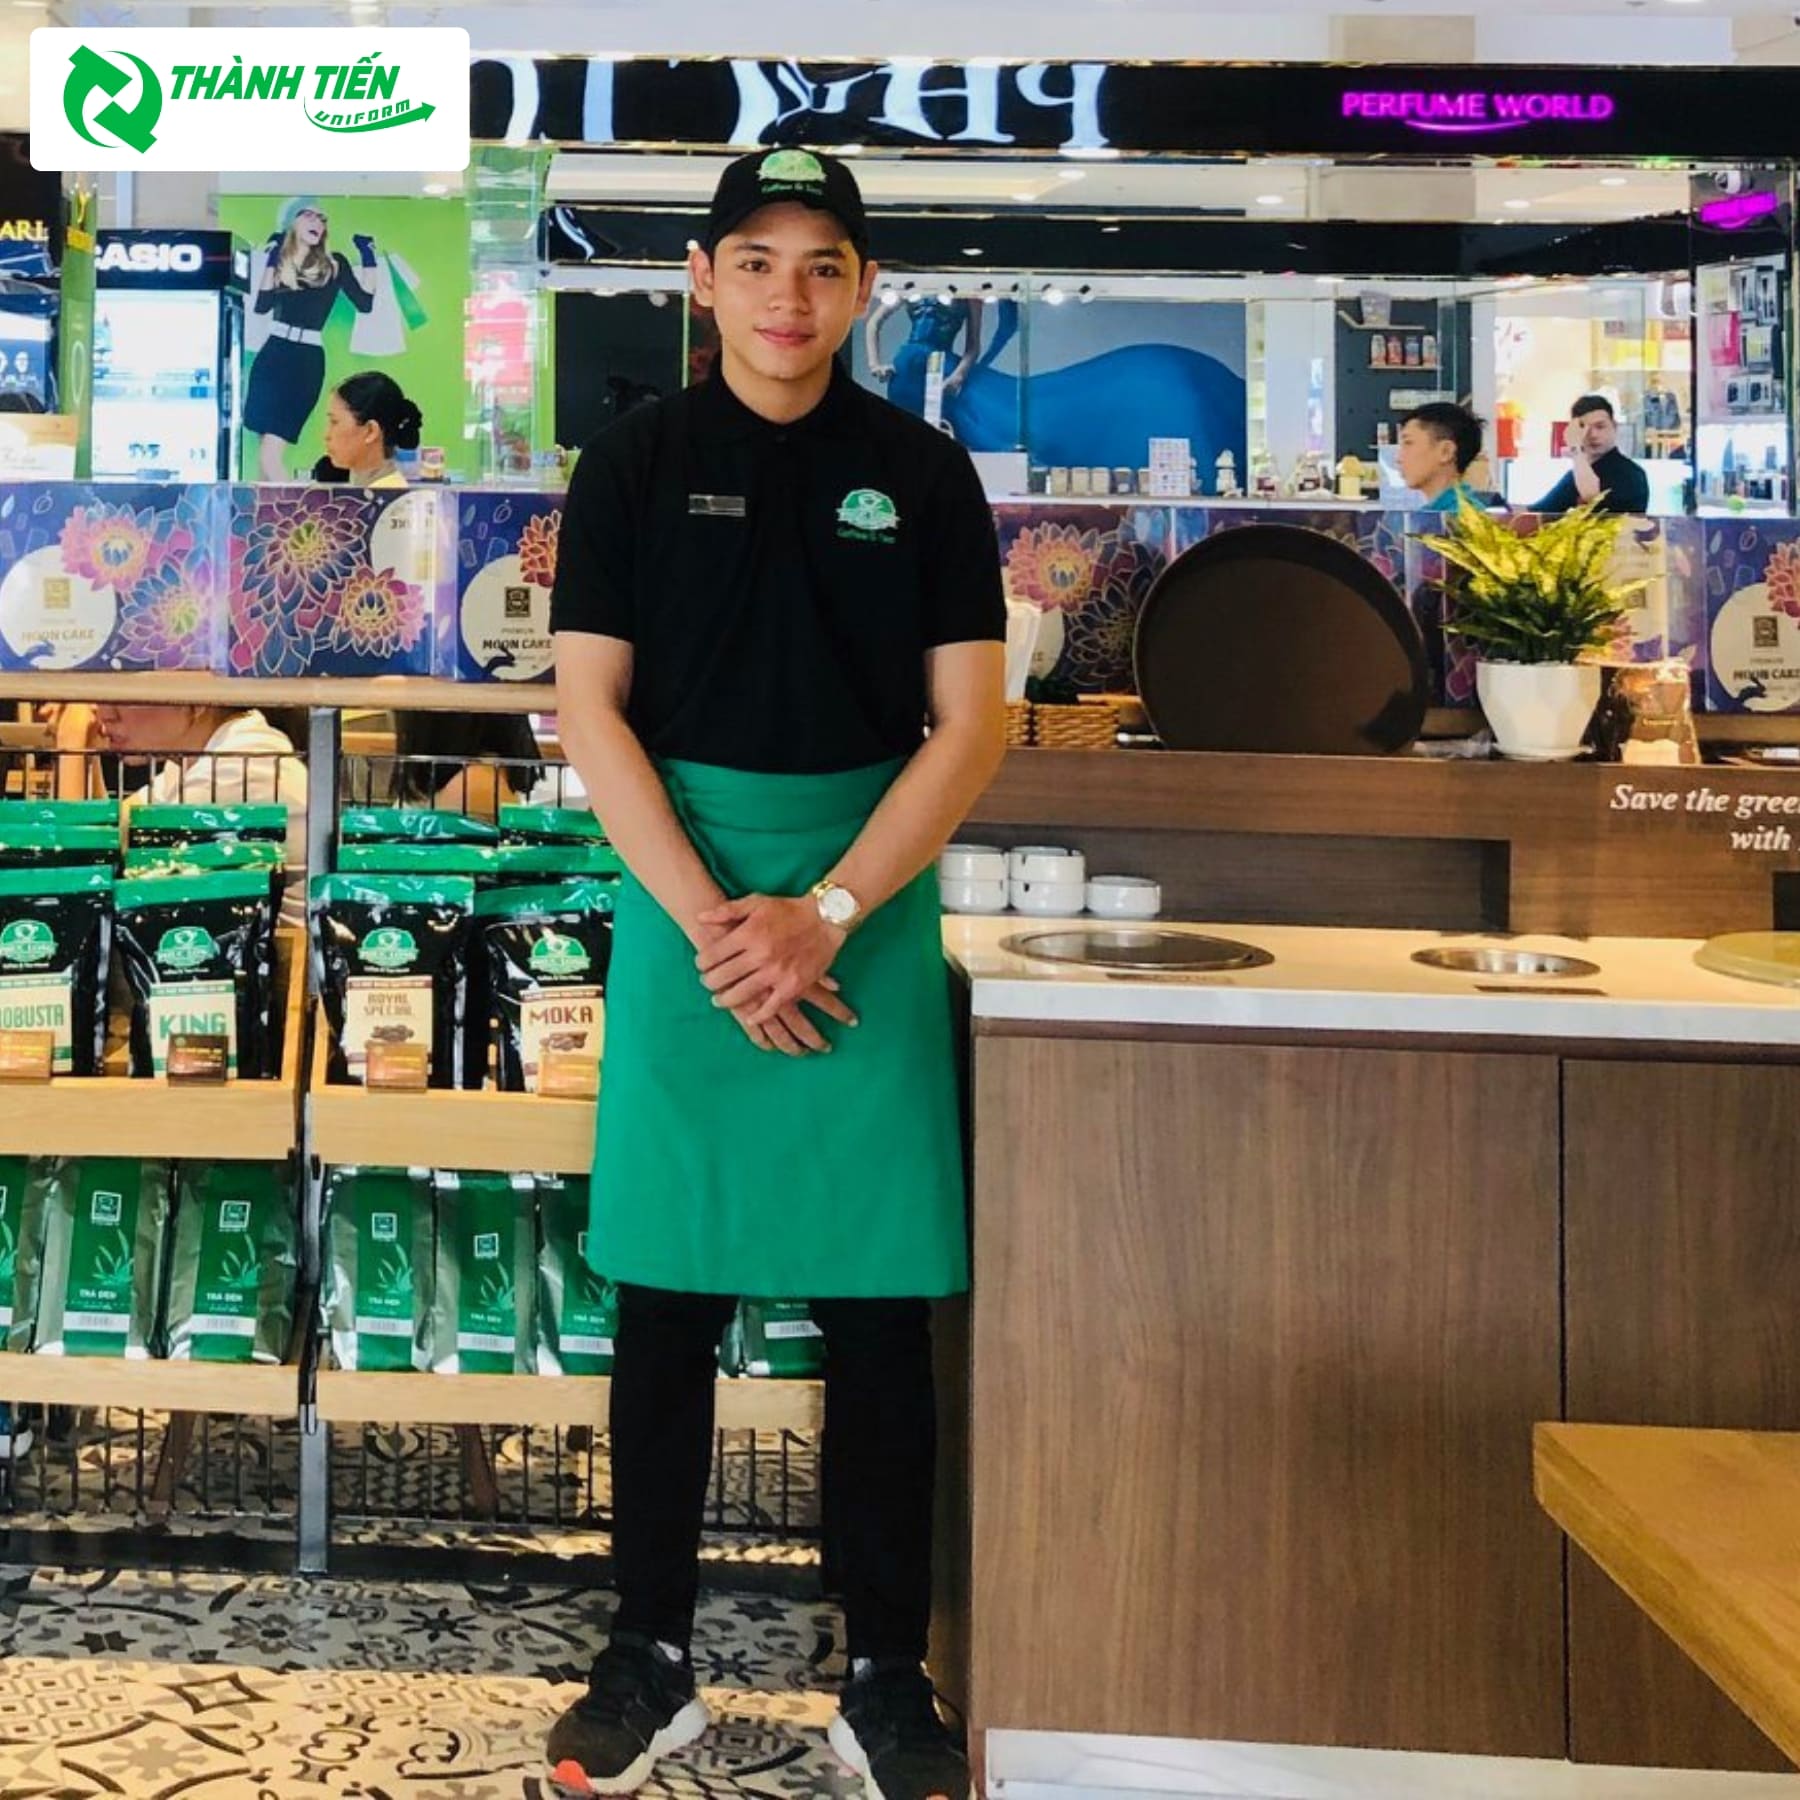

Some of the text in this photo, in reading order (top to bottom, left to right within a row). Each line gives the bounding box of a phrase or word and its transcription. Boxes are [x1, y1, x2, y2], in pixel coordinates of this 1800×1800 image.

[1341, 91, 1615, 120] PERFUME WORLD
[482, 638, 553, 650] MOON CAKE
[1610, 784, 1800, 820] Save the gree
[1730, 825, 1791, 851] with
[159, 1012, 227, 1040] KING
[529, 1005, 593, 1026] MOKA
